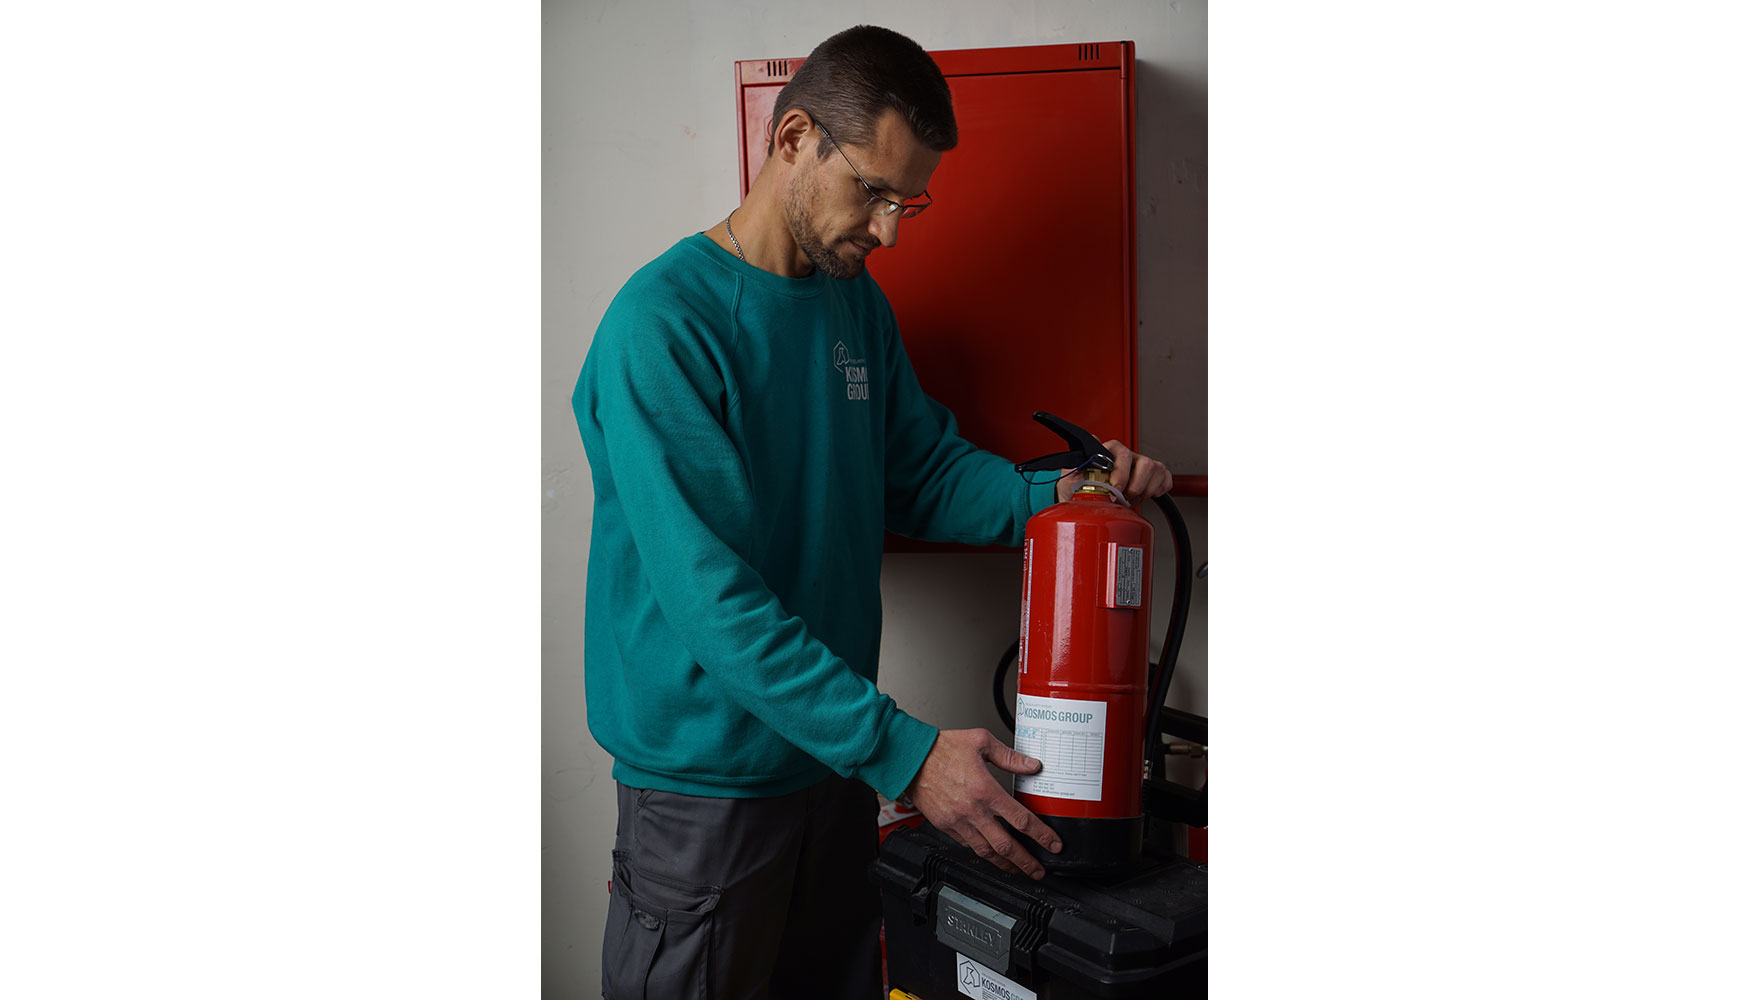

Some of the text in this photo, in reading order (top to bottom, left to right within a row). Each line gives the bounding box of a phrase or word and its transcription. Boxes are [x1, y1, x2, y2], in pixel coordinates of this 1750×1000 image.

[1024, 708, 1093, 723] KOSMOS GROUP
[946, 914, 994, 947] STANLEY
[981, 976, 1011, 1000] KOSMOS
